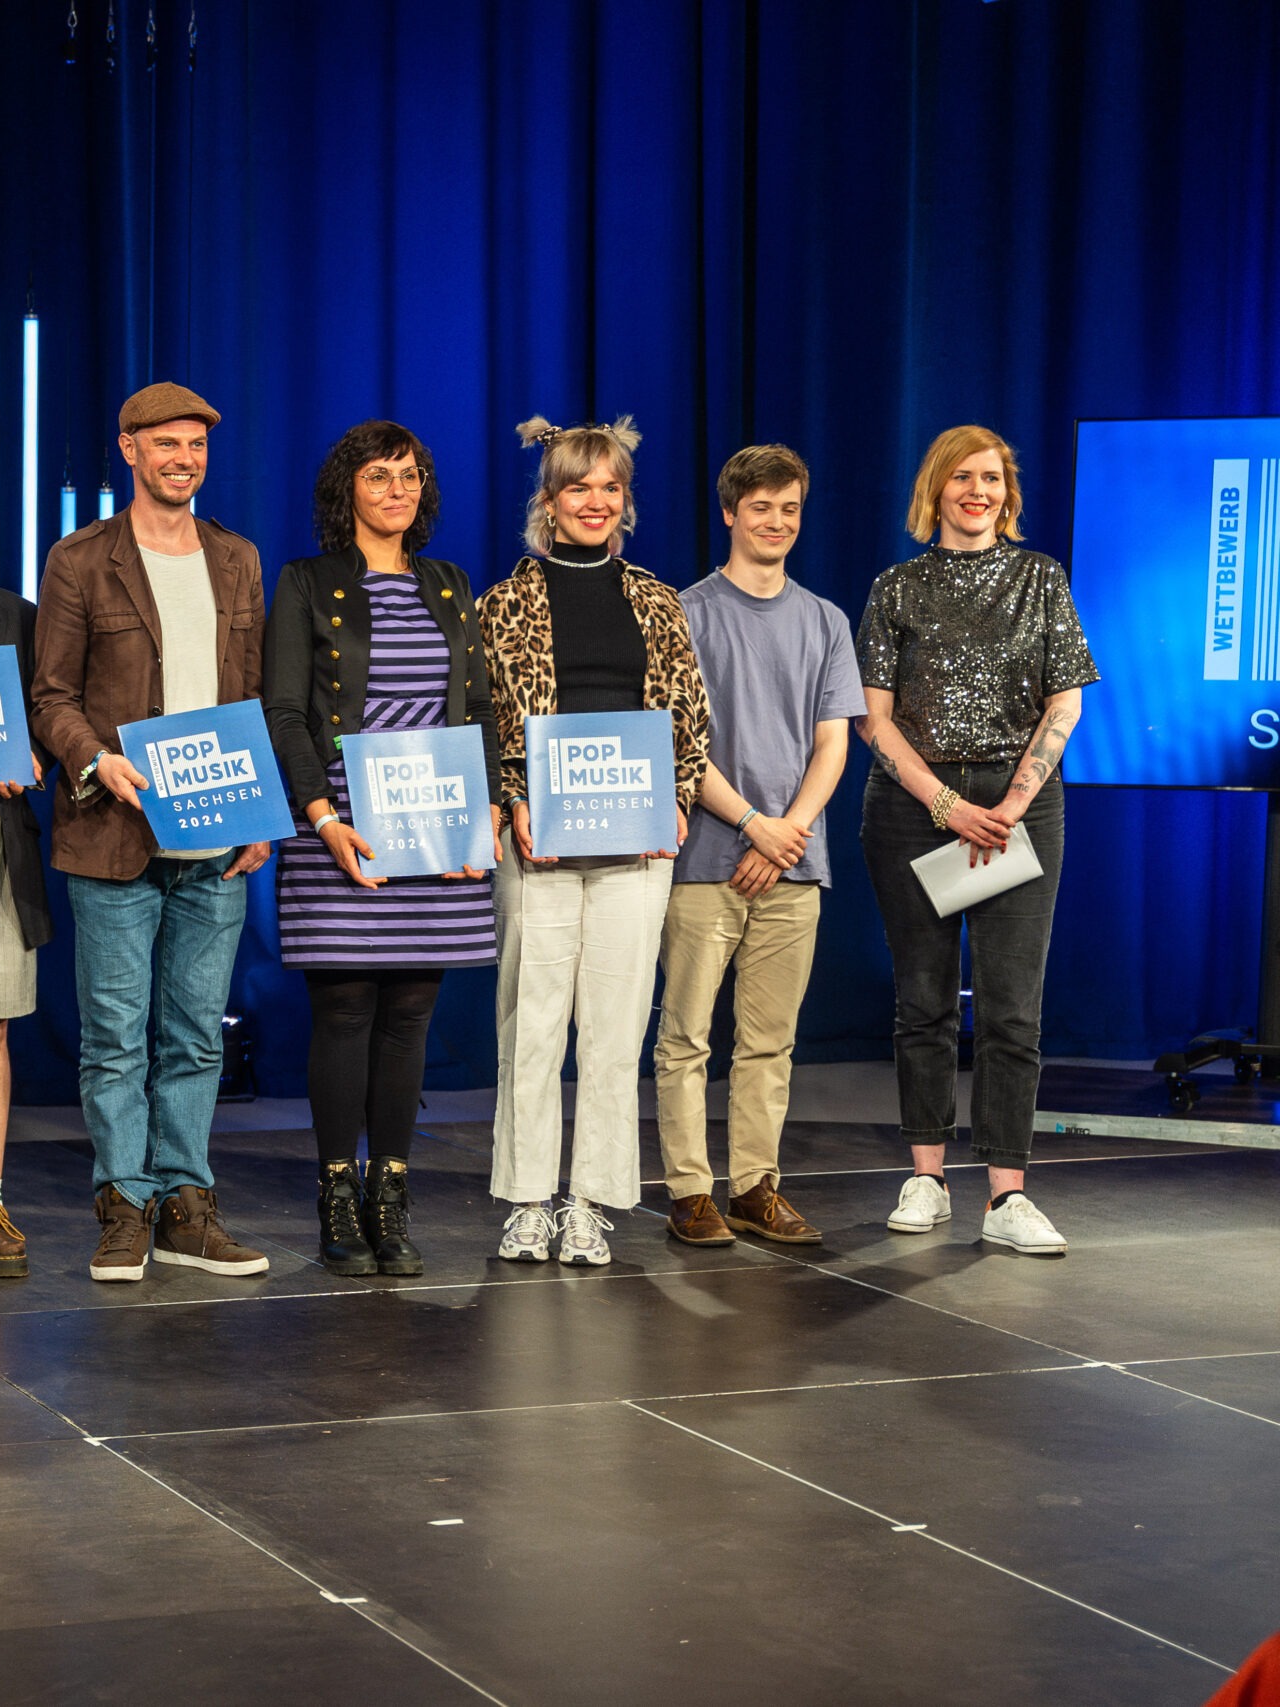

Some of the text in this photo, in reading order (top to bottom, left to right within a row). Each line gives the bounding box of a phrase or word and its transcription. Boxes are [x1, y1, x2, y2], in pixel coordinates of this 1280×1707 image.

[1212, 486, 1241, 652] WETTBEWERB
[165, 740, 214, 764] POP
[567, 743, 616, 763] POP
[171, 757, 249, 788] MUSIK
[382, 762, 430, 782] POP
[569, 766, 645, 786] MUSIK
[173, 785, 263, 812] SACHSEN
[386, 783, 459, 806] MUSIK
[563, 796, 654, 811] SACHSEN
[178, 812, 224, 829] 2024
[384, 813, 469, 831] SACHSEN
[563, 817, 609, 831] 2024
[387, 837, 427, 850] 2024
